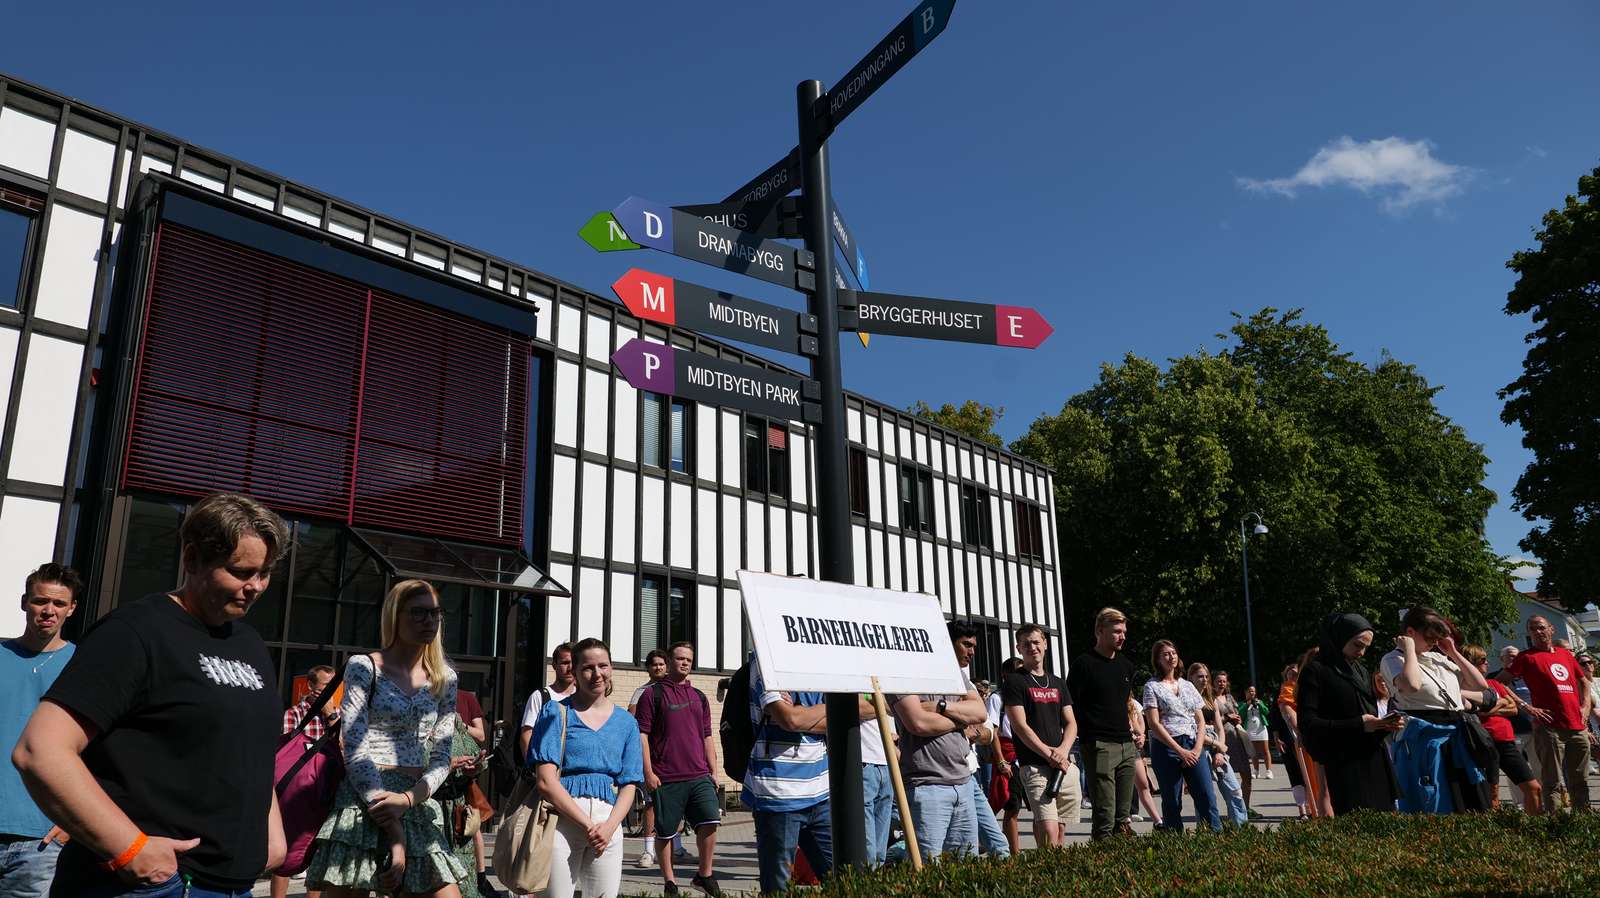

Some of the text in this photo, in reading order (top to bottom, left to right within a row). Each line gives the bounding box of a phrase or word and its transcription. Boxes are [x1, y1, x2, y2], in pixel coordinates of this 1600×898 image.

[830, 6, 935, 114] HOVEDINNGANG B
[642, 210, 784, 272] D DRAMABYGG
[640, 281, 780, 336] M MIDTBYEN
[858, 303, 1025, 339] BRYGGERHUSET E
[642, 352, 801, 407] P MIDTBYEN PARK
[781, 614, 935, 654] BARNEHAGELÆRER
